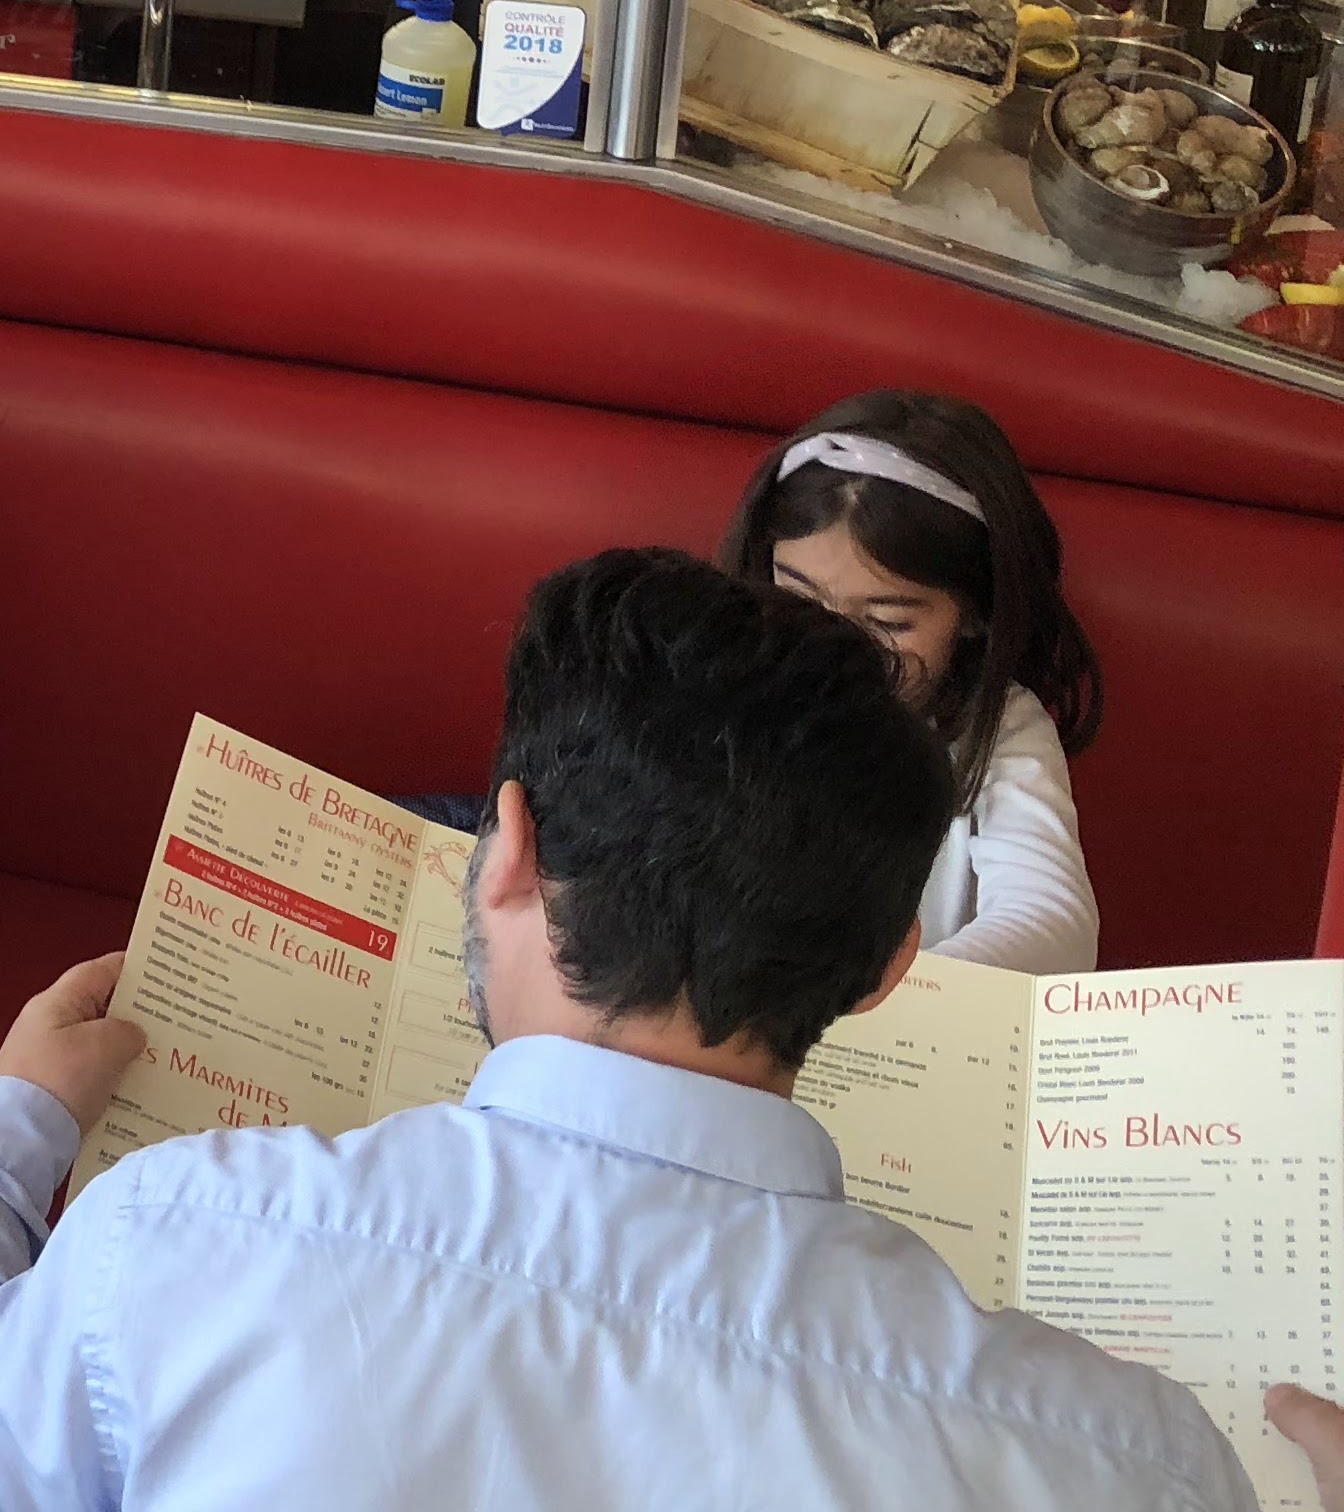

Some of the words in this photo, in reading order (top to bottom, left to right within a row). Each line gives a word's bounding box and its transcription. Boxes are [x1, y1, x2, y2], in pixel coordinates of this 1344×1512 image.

[505, 11, 566, 24] CONTRÔLE
[504, 35, 563, 54] 2018
[368, 930, 389, 952] 19
